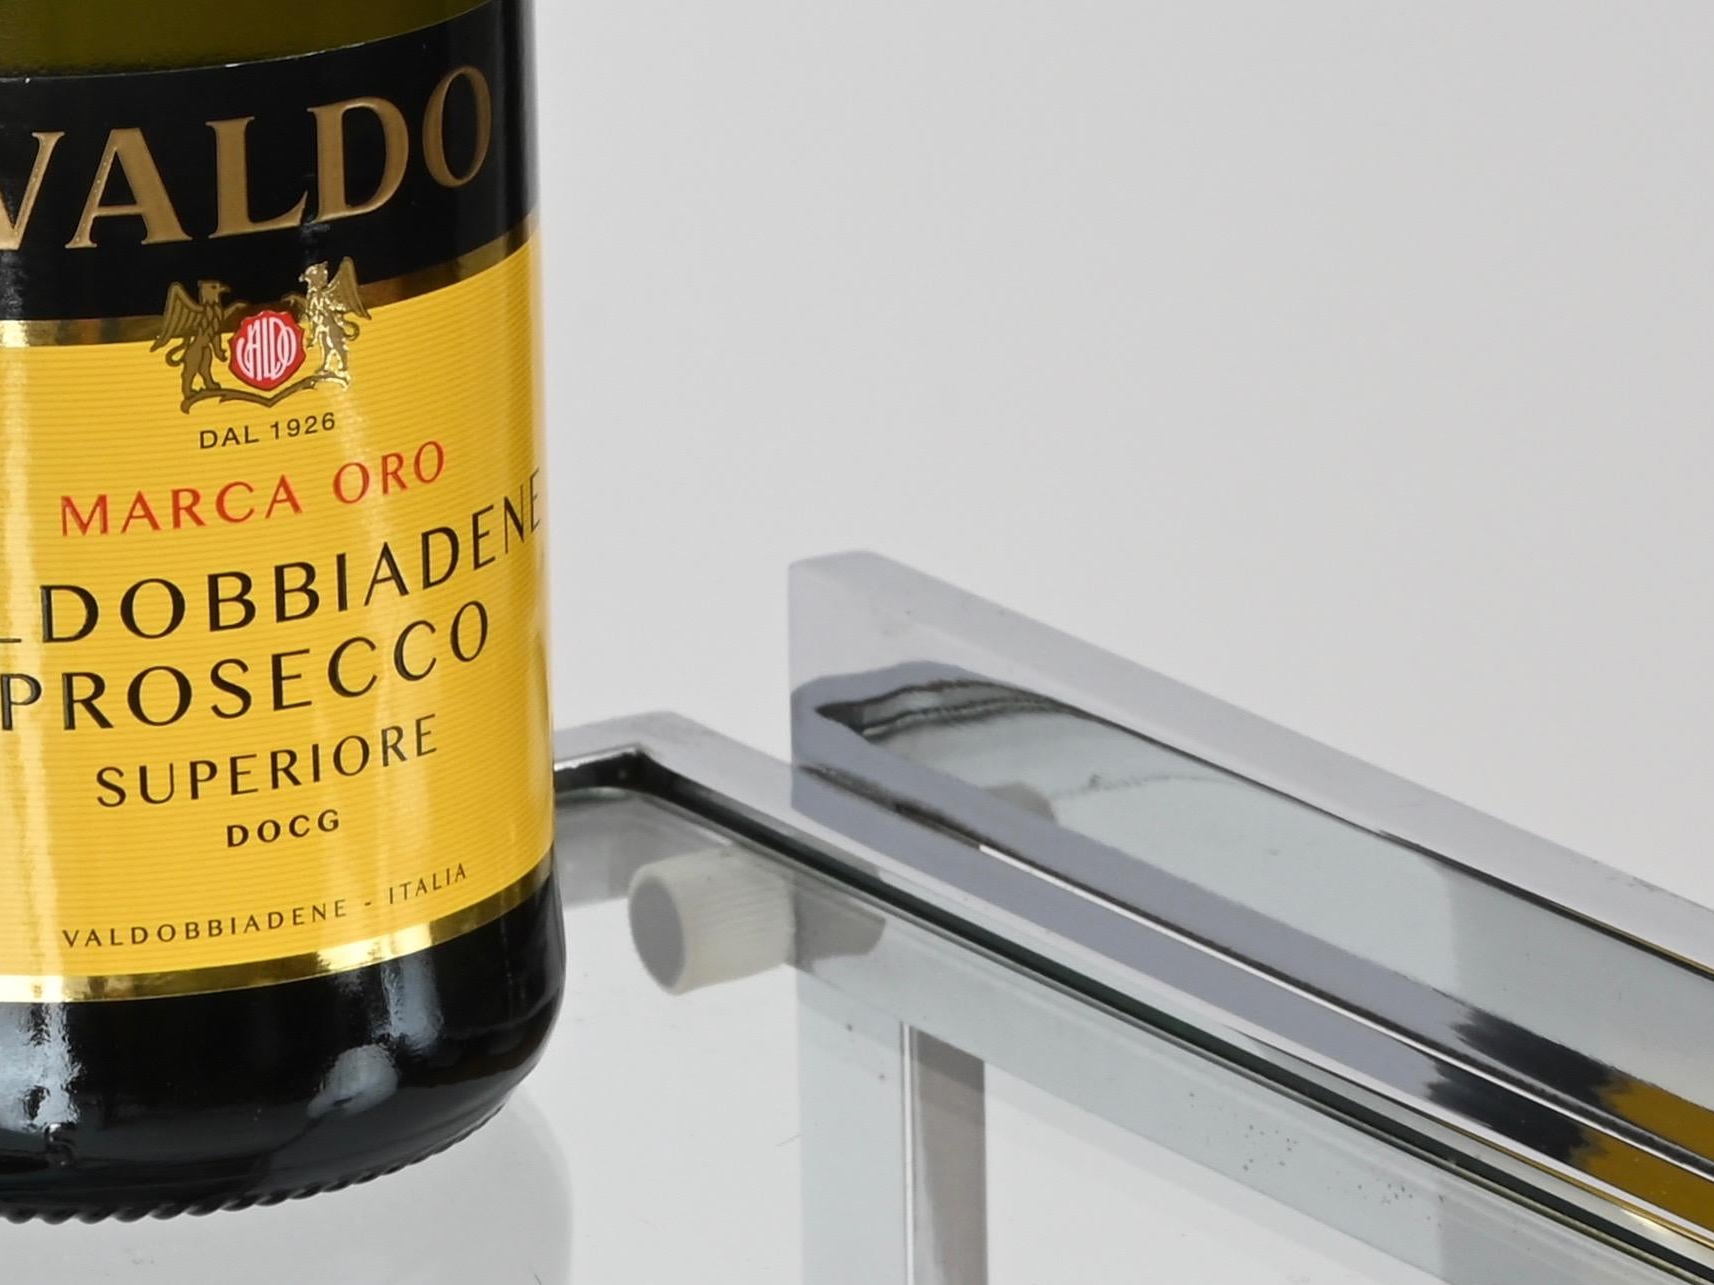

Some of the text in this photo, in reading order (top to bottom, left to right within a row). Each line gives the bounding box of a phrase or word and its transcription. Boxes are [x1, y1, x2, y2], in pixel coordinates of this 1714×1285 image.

[199, 412, 336, 449] DAL 1926
[61, 440, 446, 537] MARCA ORO
[0, 600, 490, 732] PROSECCO
[95, 713, 438, 808] SUPERIORE
[226, 809, 341, 848] DOCG
[62, 899, 348, 948] VALDOBBIADENE
[388, 862, 468, 906] ITALIA
